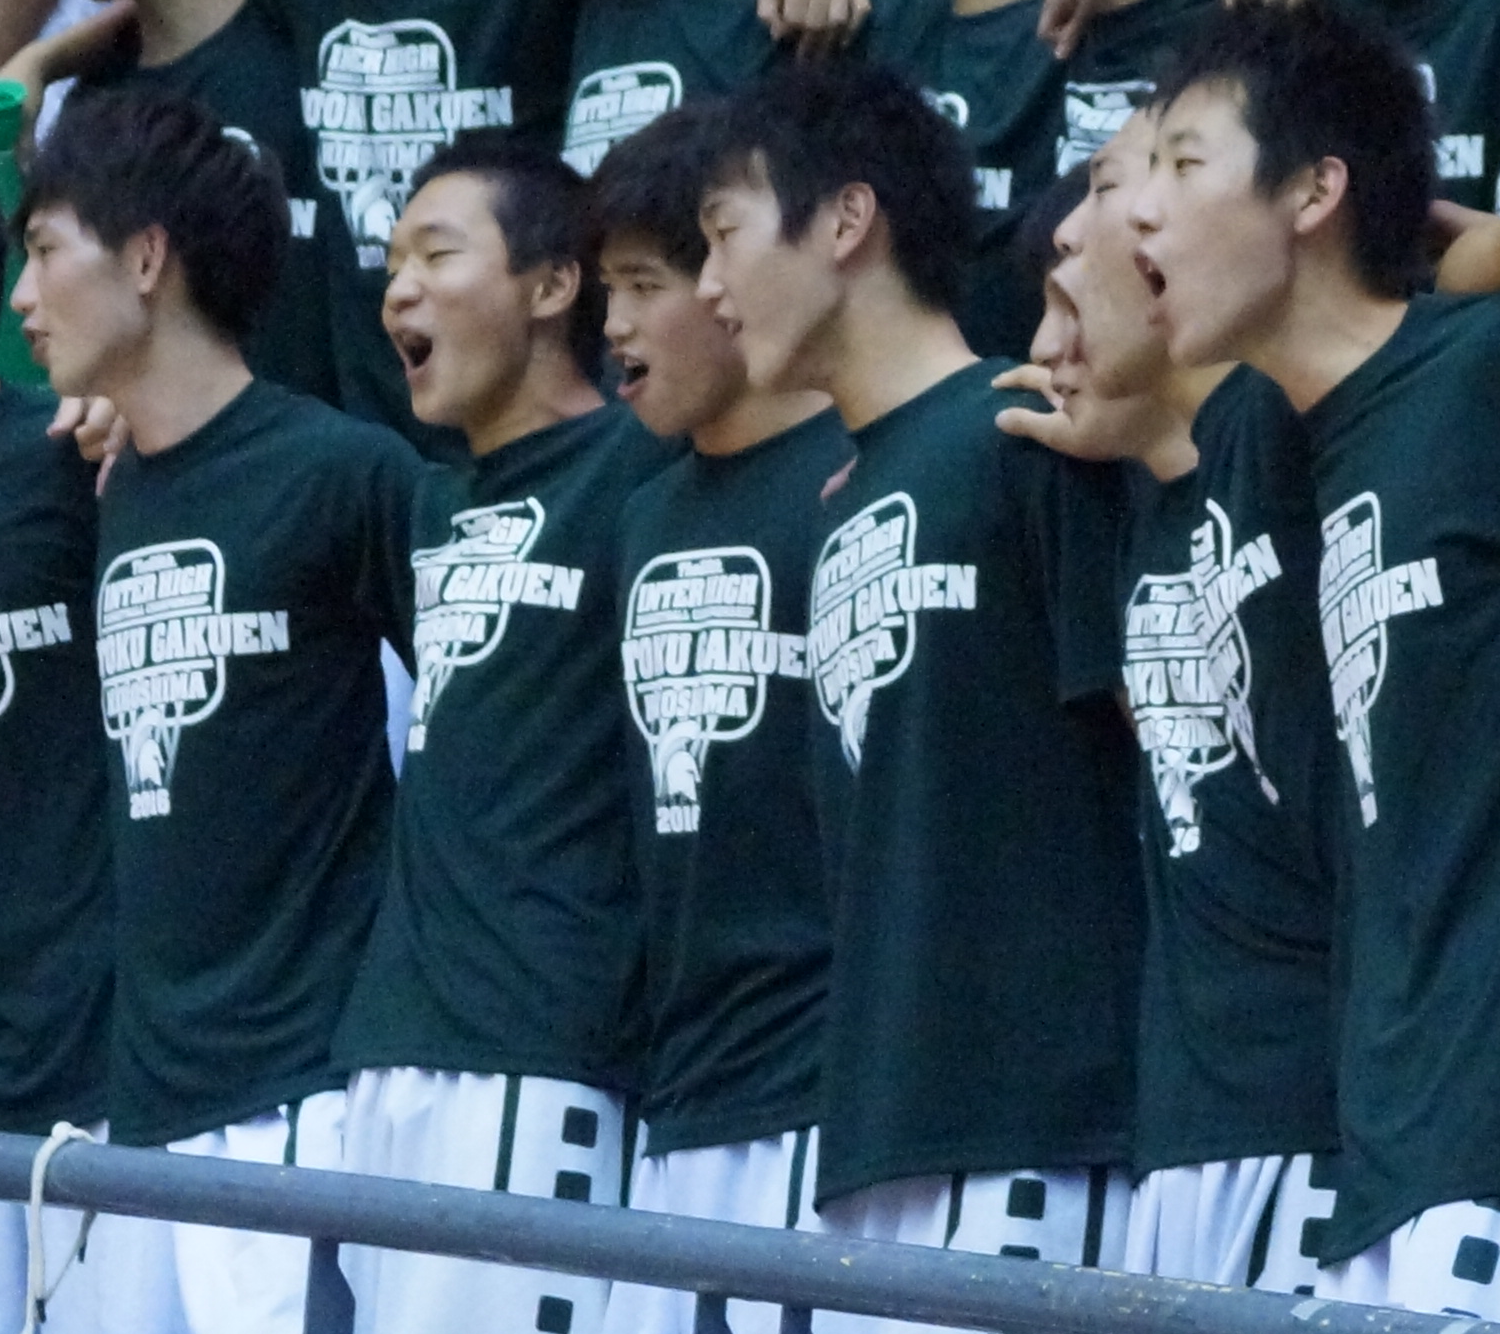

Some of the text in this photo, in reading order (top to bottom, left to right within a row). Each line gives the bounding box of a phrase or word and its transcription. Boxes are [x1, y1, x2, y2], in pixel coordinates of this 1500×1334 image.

[371, 84, 514, 131] GAKUEN
[443, 562, 585, 611] GAKUEN
[854, 563, 978, 632] GAKUEN
[150, 609, 291, 664] GAKUEN
